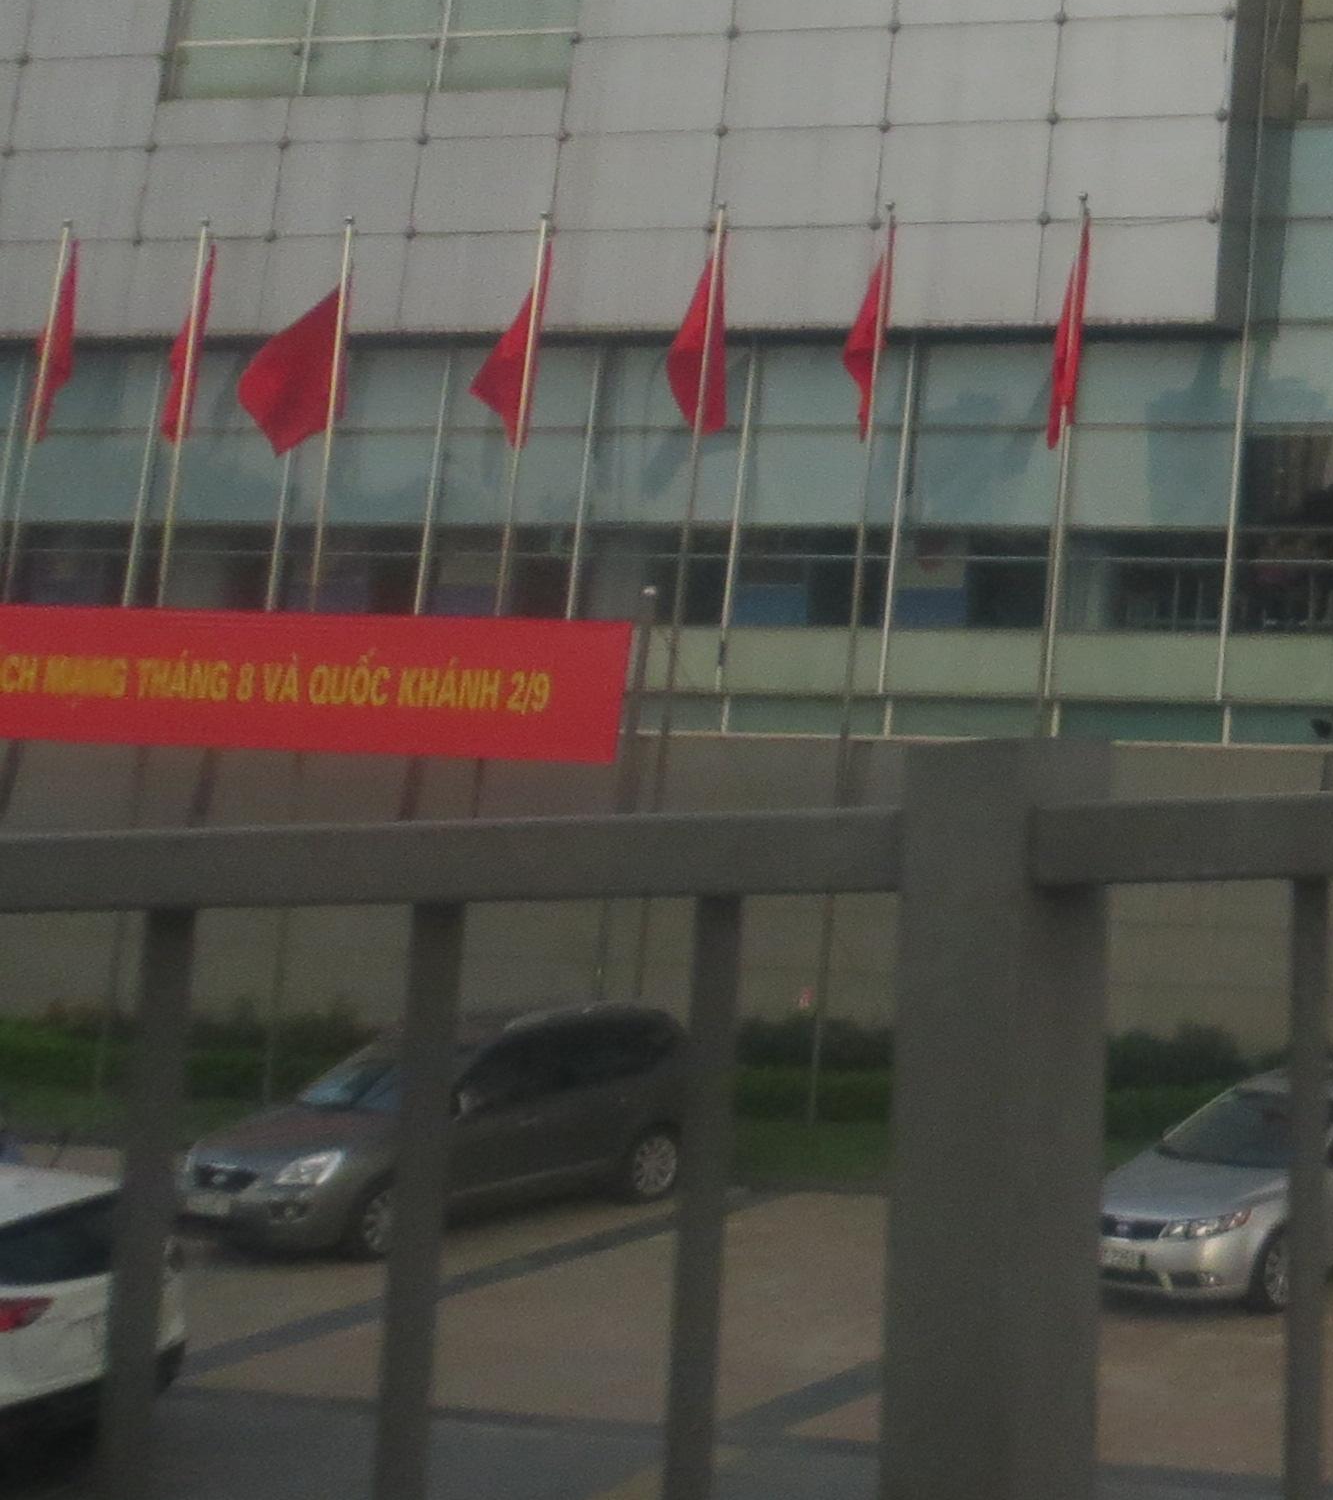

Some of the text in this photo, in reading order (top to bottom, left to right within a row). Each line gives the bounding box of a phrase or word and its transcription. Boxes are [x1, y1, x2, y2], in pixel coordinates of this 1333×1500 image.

[0, 654, 38, 693] CH
[136, 649, 229, 700] THÁNG
[235, 661, 255, 703] 8
[262, 652, 299, 703] VÀ
[307, 648, 392, 706] QUỐC
[397, 656, 502, 711] KHÁNH
[506, 669, 552, 716] 2/9
